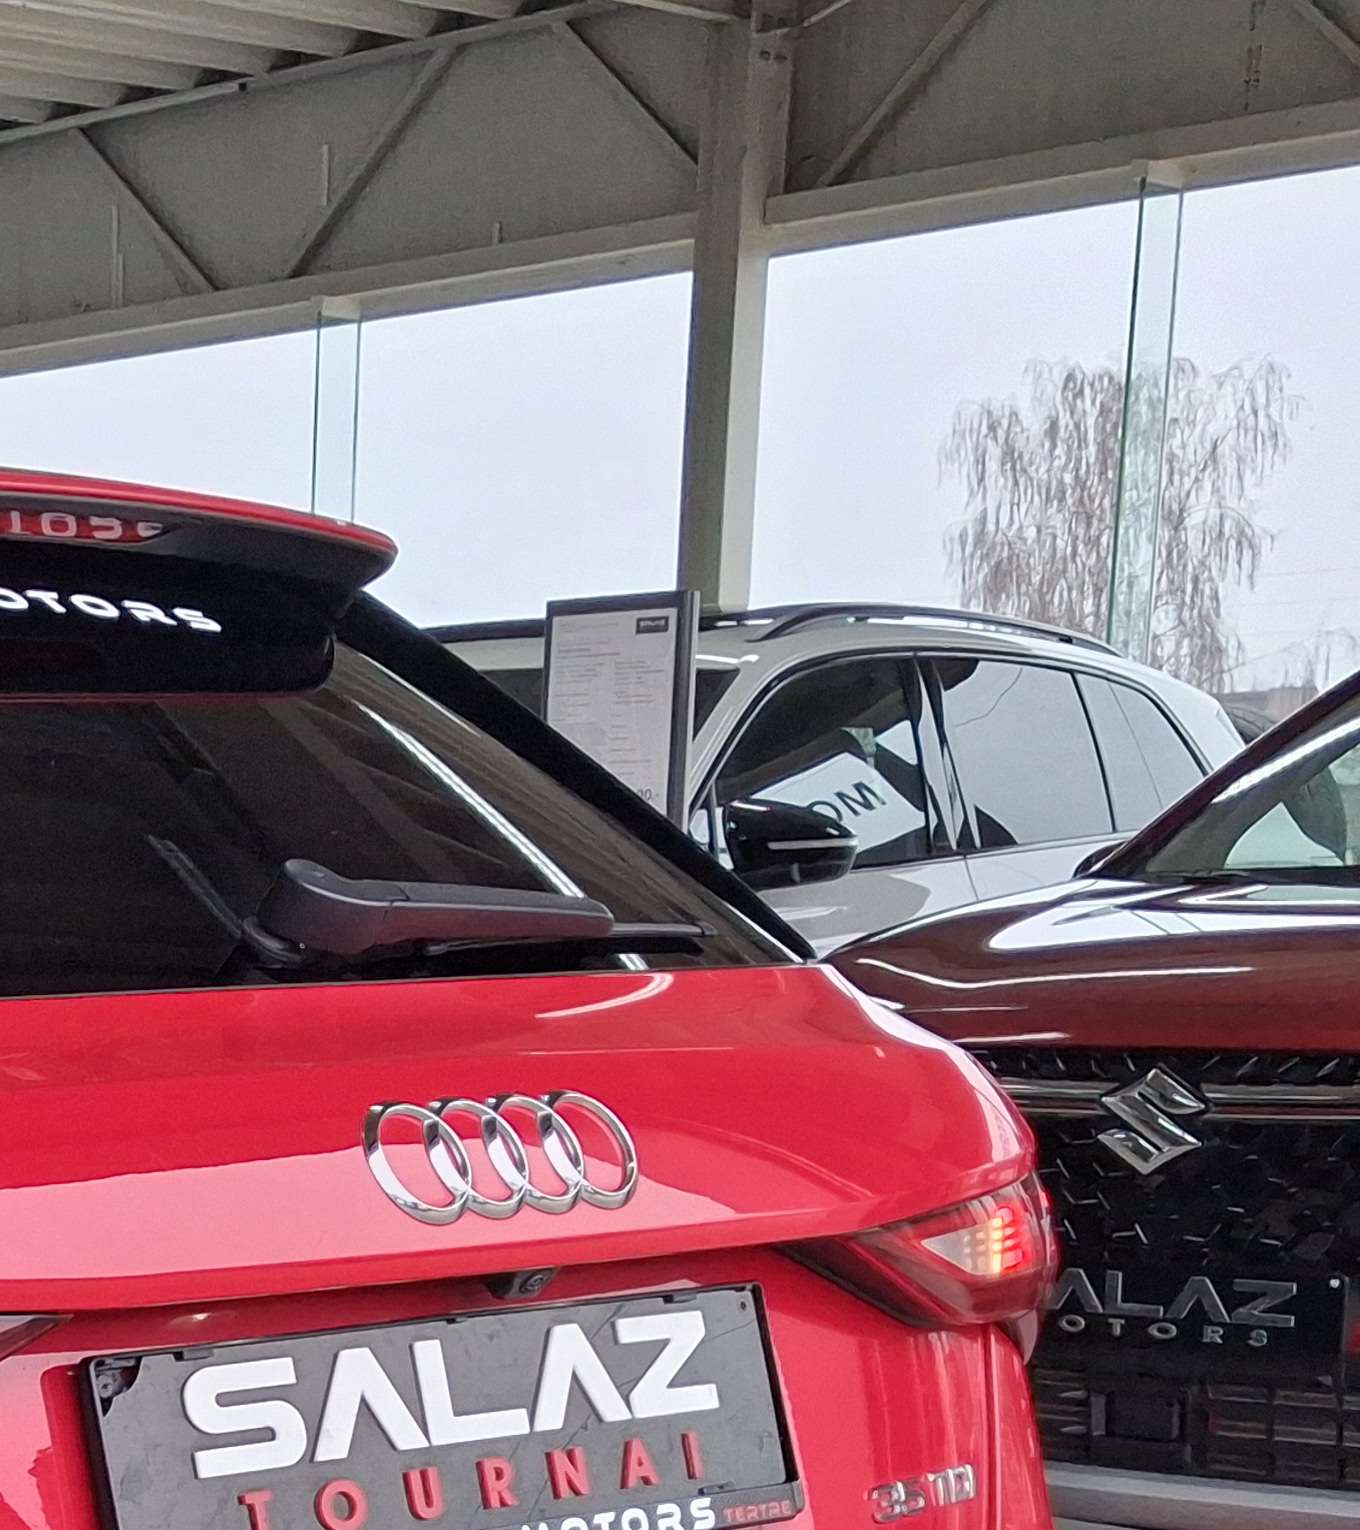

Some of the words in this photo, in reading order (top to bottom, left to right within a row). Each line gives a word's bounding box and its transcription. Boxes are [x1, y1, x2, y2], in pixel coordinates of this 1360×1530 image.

[1048, 1267, 1298, 1328] ALAZ
[1057, 1313, 1269, 1348] OTORS
[183, 1309, 720, 1480] SALAZ
